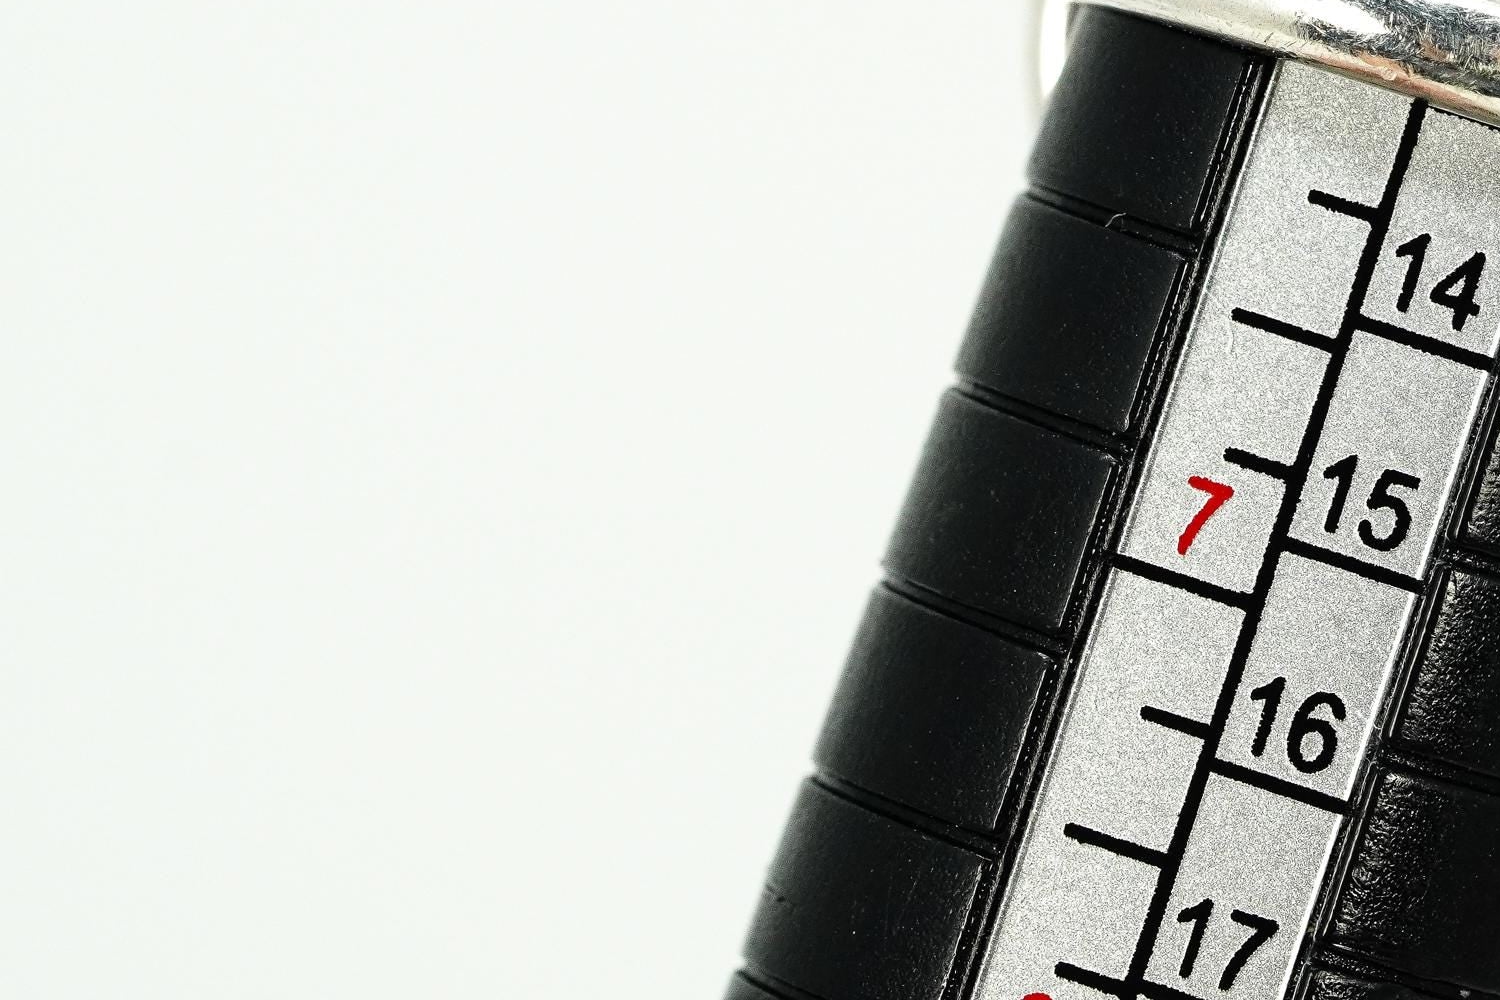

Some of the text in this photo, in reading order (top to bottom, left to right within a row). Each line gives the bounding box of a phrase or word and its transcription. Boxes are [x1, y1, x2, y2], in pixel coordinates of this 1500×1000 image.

[1395, 232, 1487, 333] 14
[1177, 475, 1235, 557] 7
[1322, 454, 1422, 553] 15
[1250, 676, 1347, 775] 16
[1176, 897, 1280, 993] 17
